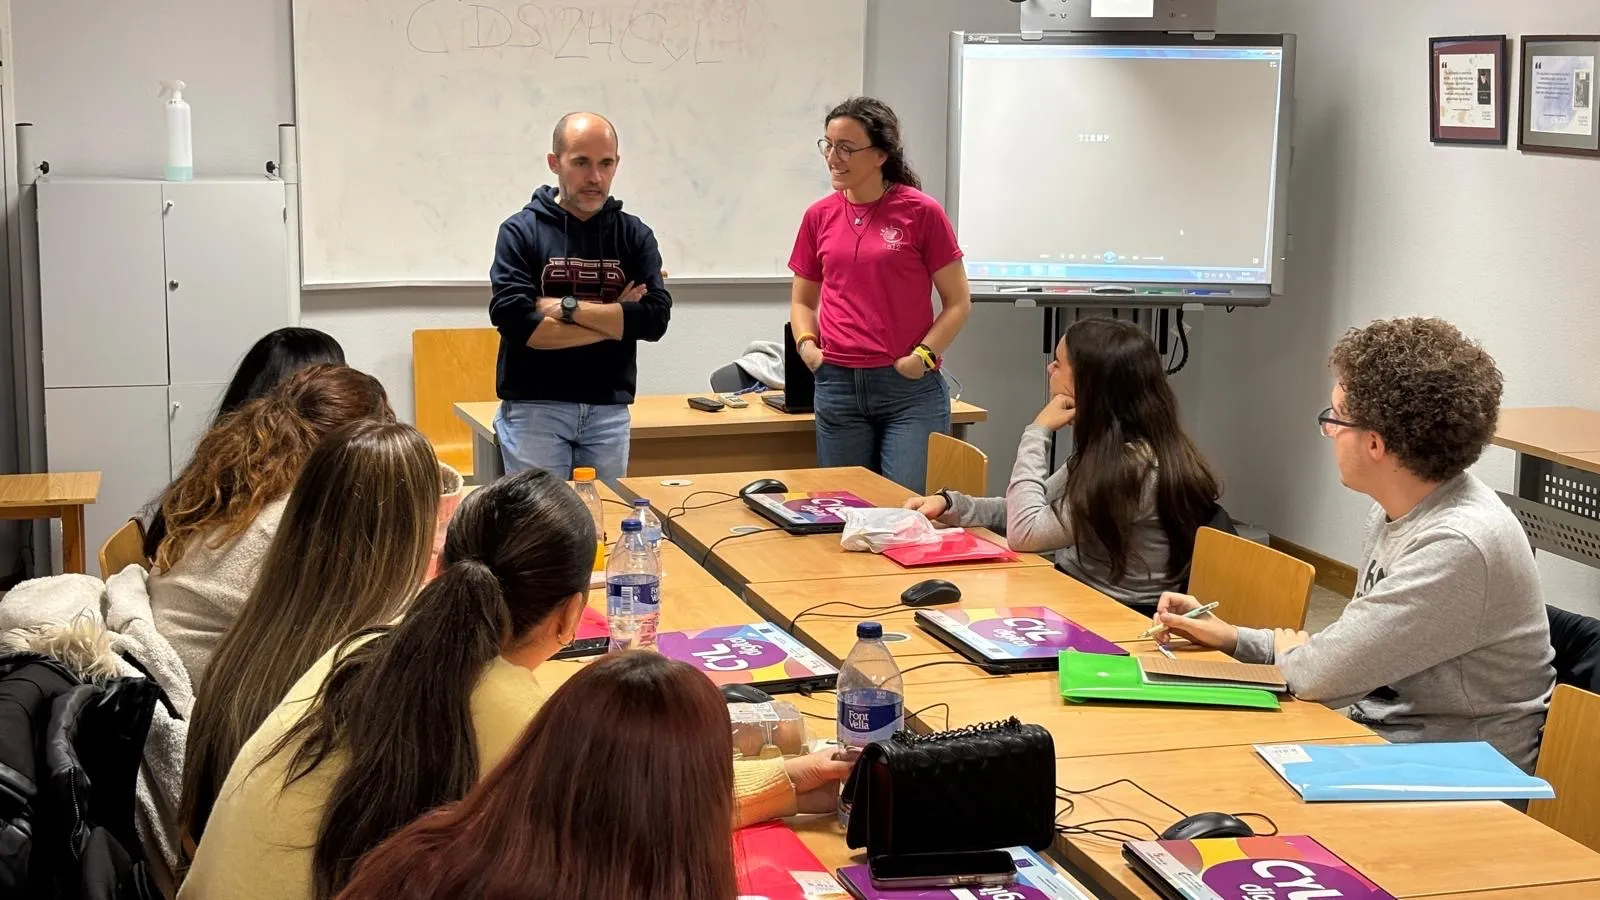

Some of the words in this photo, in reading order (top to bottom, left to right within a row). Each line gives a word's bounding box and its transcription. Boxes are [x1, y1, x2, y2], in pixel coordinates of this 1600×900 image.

[1002, 616, 1064, 641] CYL
[691, 643, 749, 671] CYL
[848, 710, 869, 721] Font
[849, 719, 870, 730] Vella
